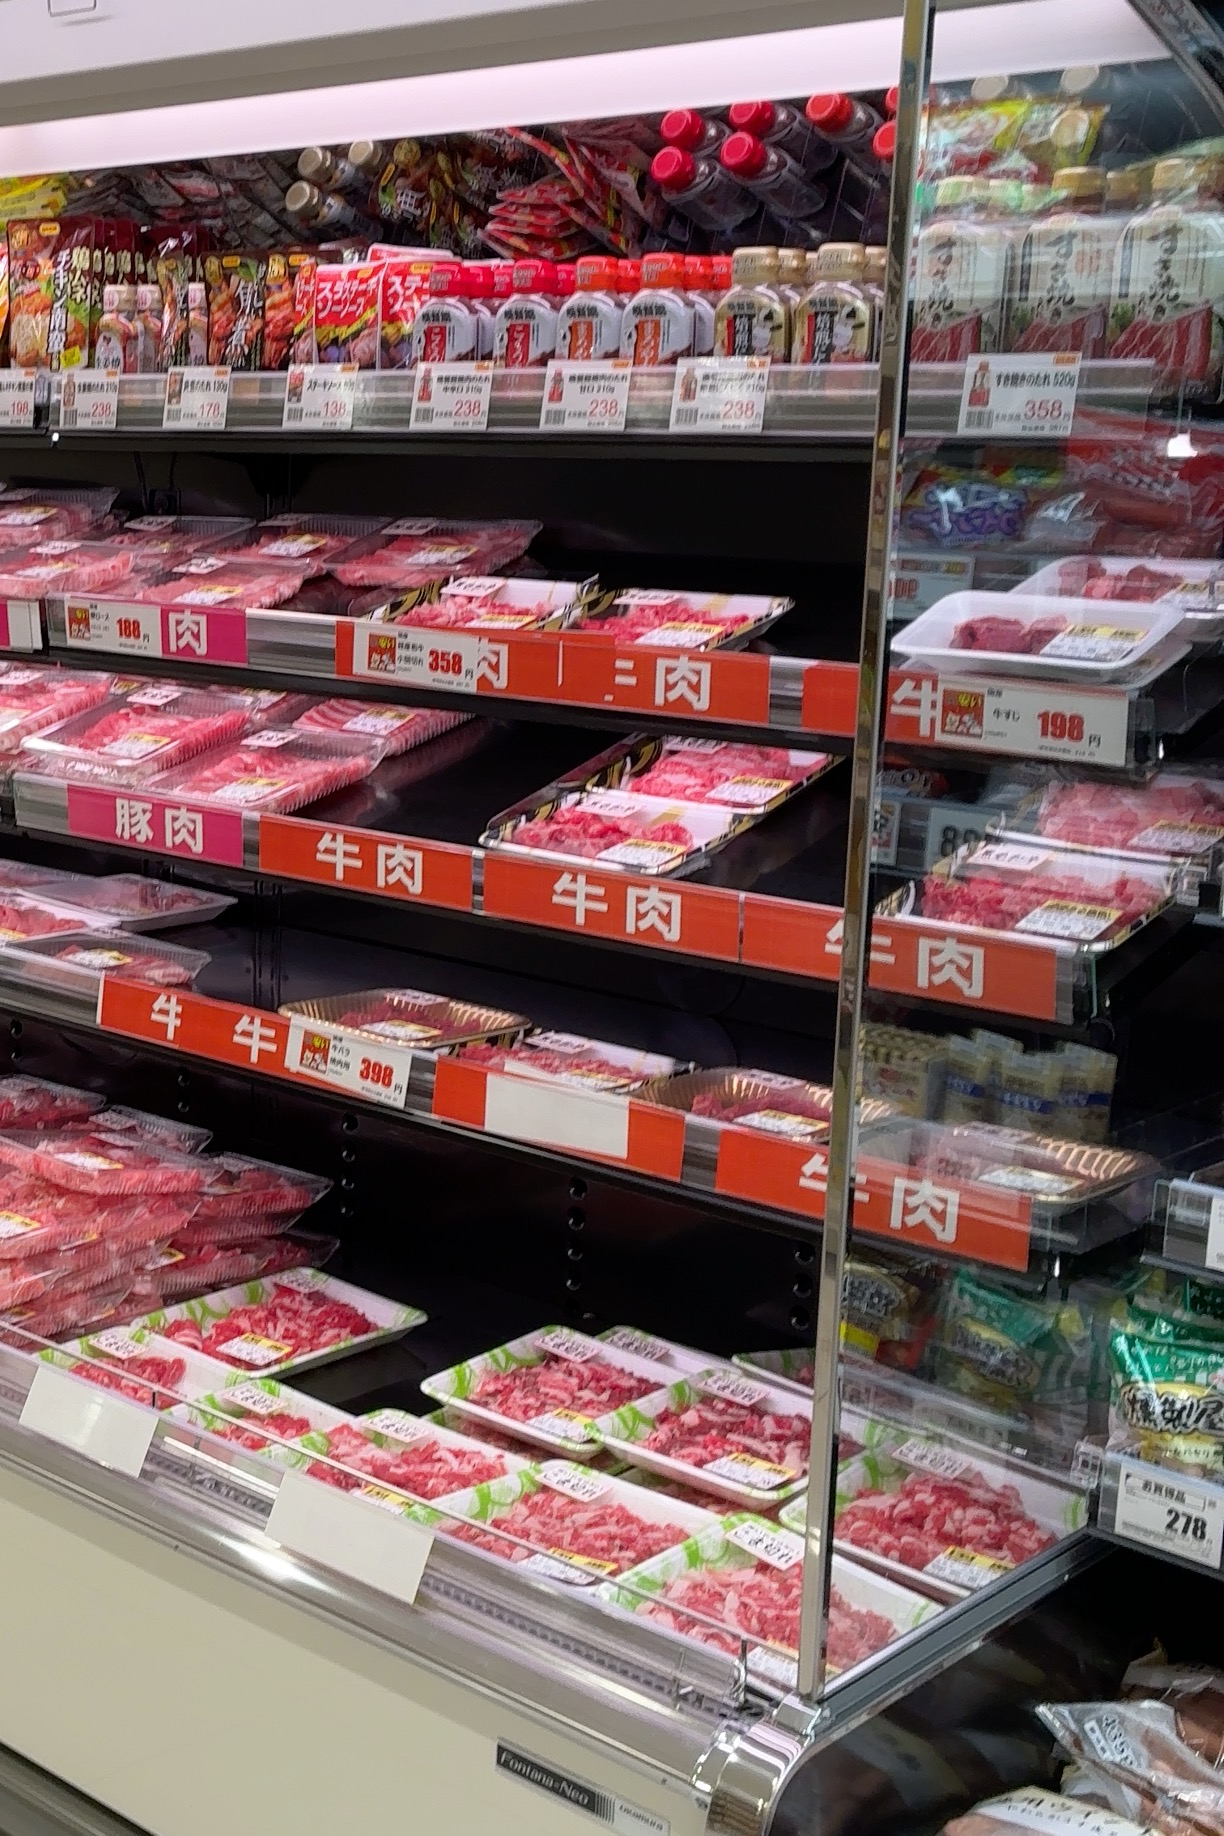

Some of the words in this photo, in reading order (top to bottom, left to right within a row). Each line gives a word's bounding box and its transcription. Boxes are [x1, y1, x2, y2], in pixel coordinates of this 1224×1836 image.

[91, 402, 112, 418] 238
[454, 399, 481, 417] 238
[589, 399, 618, 418] 238
[722, 400, 755, 419] 238
[1024, 399, 1062, 420] 358
[168, 609, 208, 656] 肉
[428, 648, 463, 676] 358
[1037, 710, 1084, 743] 198
[115, 797, 204, 855] 豚肉
[316, 833, 423, 896] 牛肉
[551, 872, 682, 943] 牛肉
[149, 993, 182, 1041] 牛
[233, 1014, 277, 1064] 牛
[359, 1056, 394, 1089] 398
[1165, 1507, 1208, 1540] 278
[500, 1751, 590, 1807] Fontana-Neo
